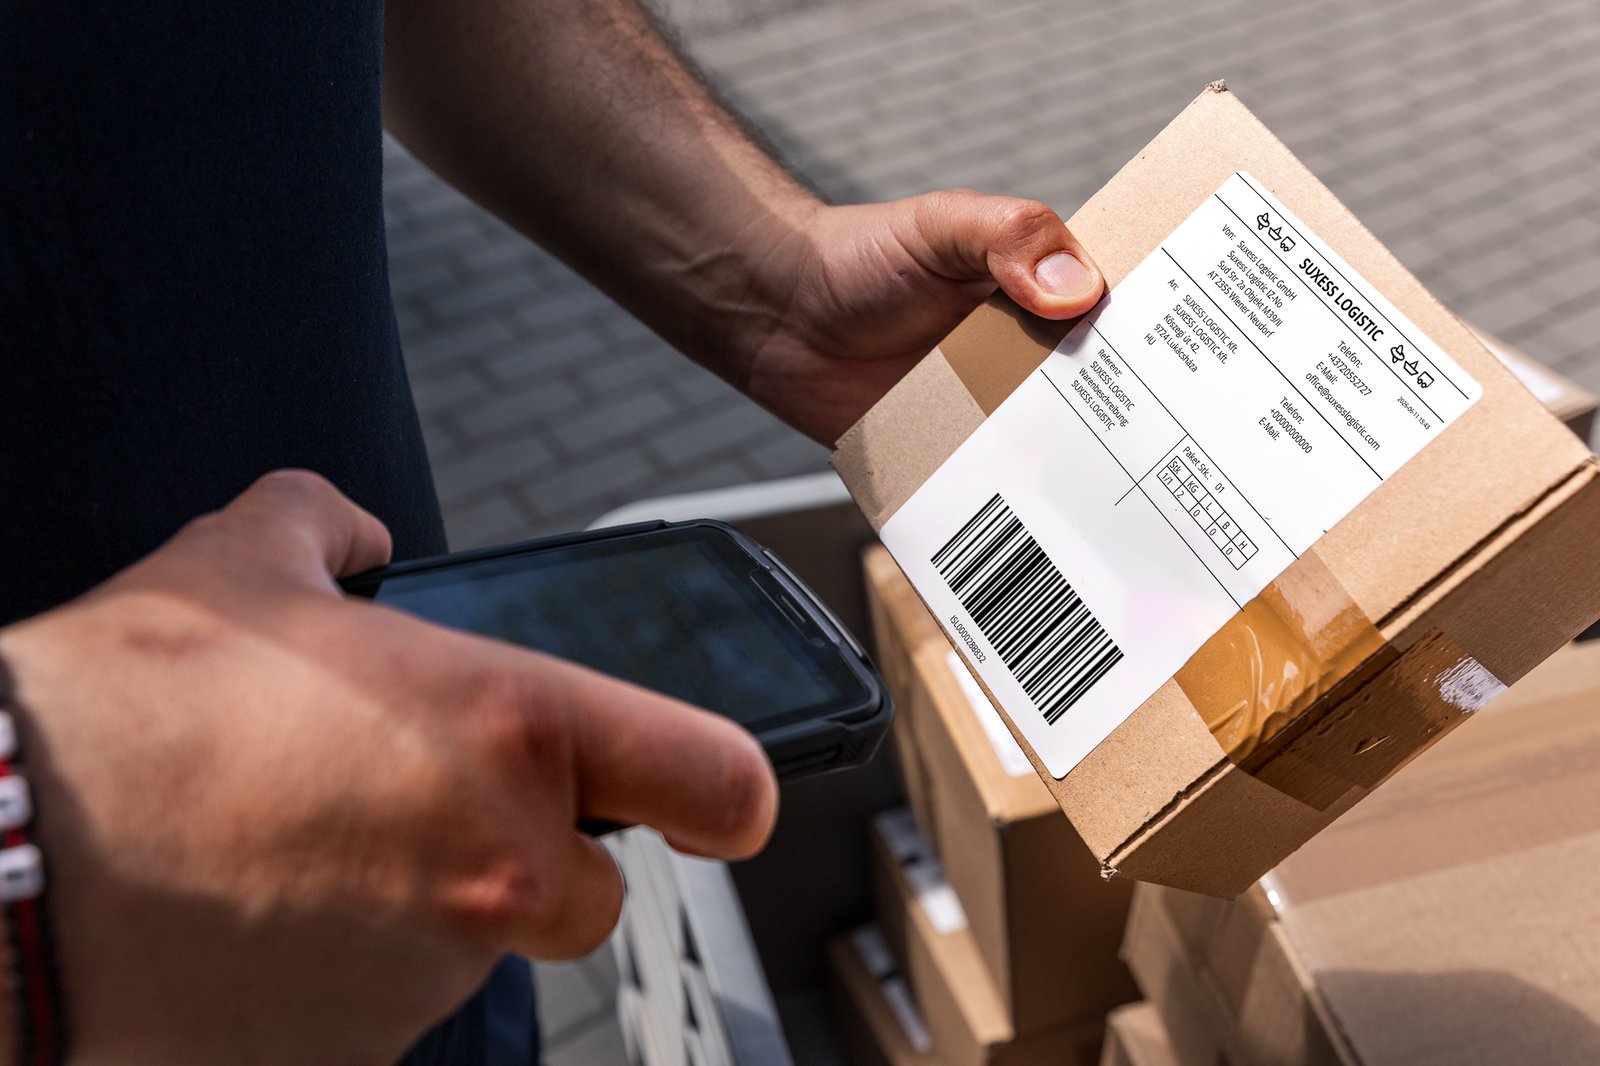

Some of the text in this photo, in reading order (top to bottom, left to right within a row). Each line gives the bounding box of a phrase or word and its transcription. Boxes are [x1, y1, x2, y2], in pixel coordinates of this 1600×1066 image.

[1217, 260, 1232, 275] Sud
[1227, 271, 1239, 282] Str
[1236, 279, 1246, 291] 2a
[1243, 287, 1264, 310] Objekt
[1221, 224, 1297, 301] Von: Suxess Logistic GmbH
[1226, 250, 1283, 308] Suxess Logistic IZ-No
[1167, 278, 1237, 355] An: SUXESS LOGISTIC Kft.
[1207, 270, 1275, 338] AT 2355 Wiener Neudorf
[1298, 258, 1384, 342] SUXESS LOGISTIC
[1143, 332, 1156, 346] HU
[1153, 323, 1198, 373] 9724 Lukácsháza
[1163, 313, 1200, 354] Kőszegi út 42.
[1172, 304, 1227, 365] SUXESS LOGISTIC Kft.
[1337, 340, 1363, 369] Telefon:
[1089, 360, 1135, 412] SUXESS LOGISTIC
[1097, 348, 1123, 378] Referenz:
[1315, 361, 1338, 385] E-Mail:
[1327, 352, 1372, 396] +43720552727
[1070, 379, 1115, 431] SUXESS LOGISTIC
[1078, 367, 1129, 427] Warenbeschreibung:
[1279, 396, 1304, 425] Telefon:
[1305, 372, 1380, 451] office@suxesslogistic.com
[1258, 416, 1280, 441] E-Mail:
[1270, 408, 1313, 454] +00000000000
[1182, 446, 1225, 494] Paket Stk.: 01
[1161, 472, 1233, 556] 1/1 2 0 0 0
[1169, 460, 1248, 550] Stk KG L B H
[949, 614, 986, 664] ISL0000288832
